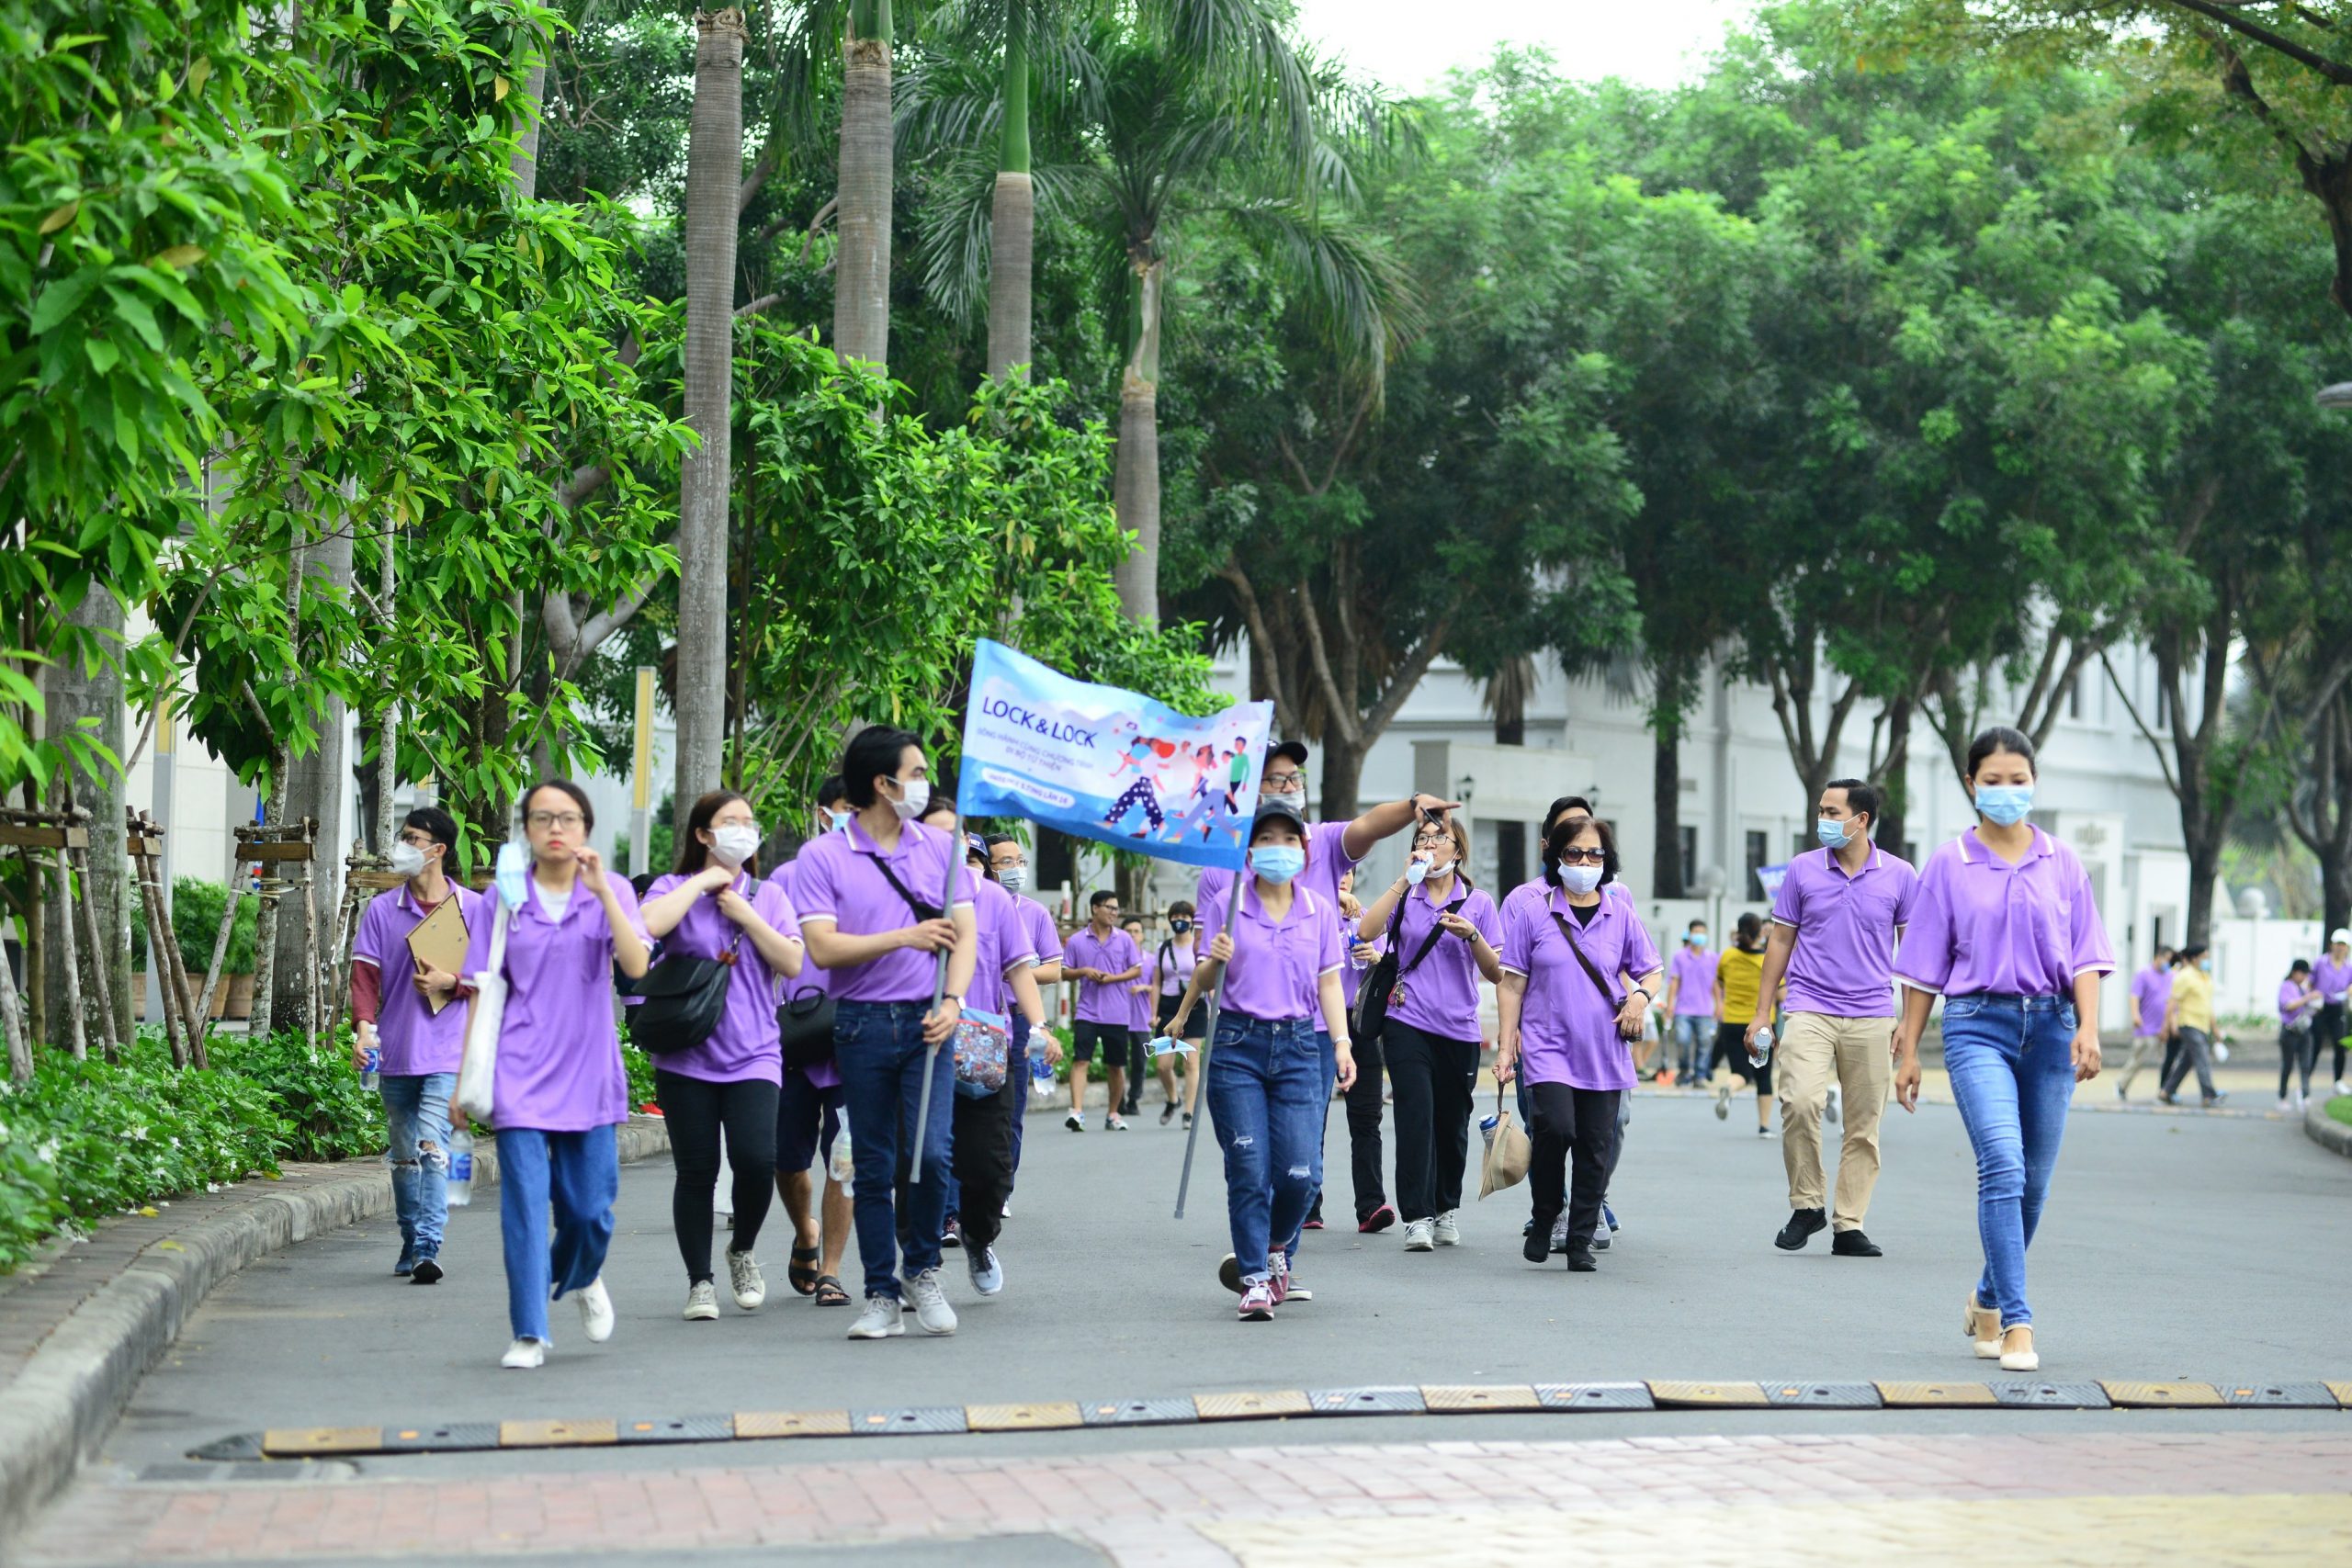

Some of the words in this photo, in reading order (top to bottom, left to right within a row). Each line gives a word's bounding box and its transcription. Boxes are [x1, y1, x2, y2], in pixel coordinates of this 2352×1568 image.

[982, 696, 1035, 729] LOCK
[1035, 718, 1049, 735] &
[1051, 722, 1098, 749] LOCK
